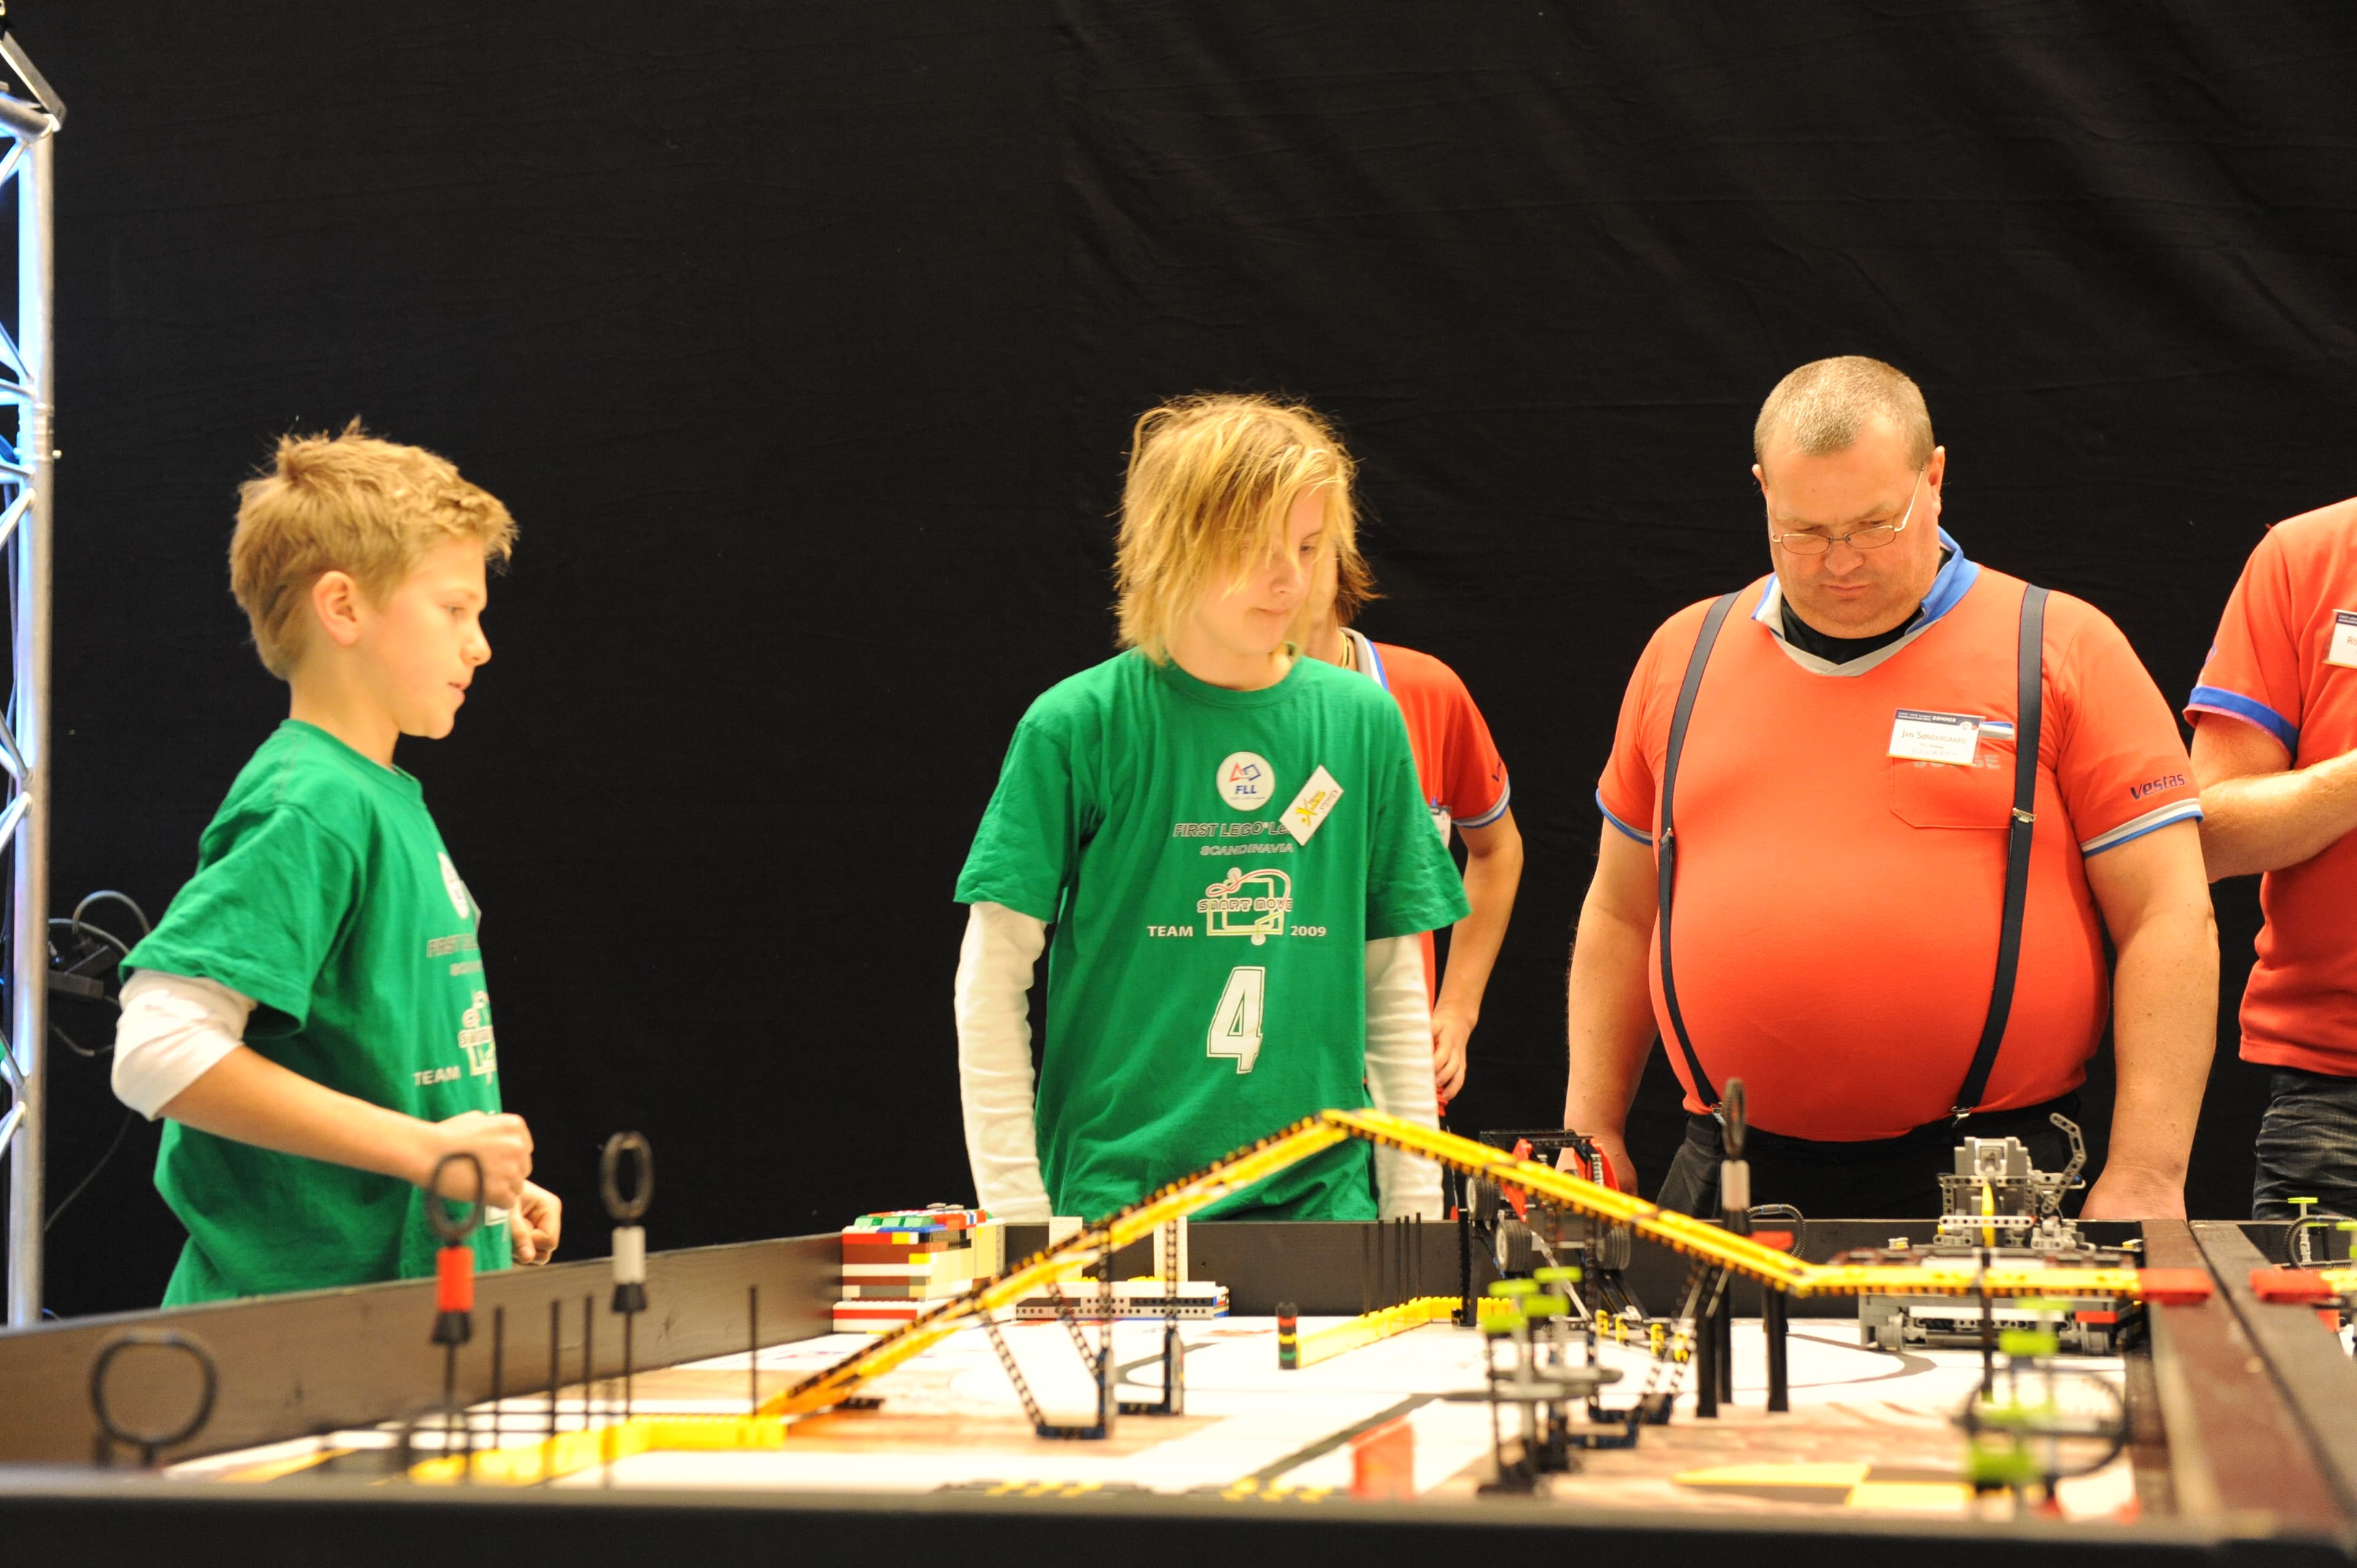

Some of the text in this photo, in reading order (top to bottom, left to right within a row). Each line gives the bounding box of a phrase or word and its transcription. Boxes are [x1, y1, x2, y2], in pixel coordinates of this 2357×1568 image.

[1235, 784, 1257, 795] FLL
[2130, 774, 2186, 800] Vestas
[1172, 823, 1219, 838] FIRST
[1199, 843, 1294, 856] SCANDINAVIA
[1147, 925, 1327, 937] TEAM 2009
[1207, 966, 1266, 1075] 4
[412, 1065, 461, 1086] TEAM
